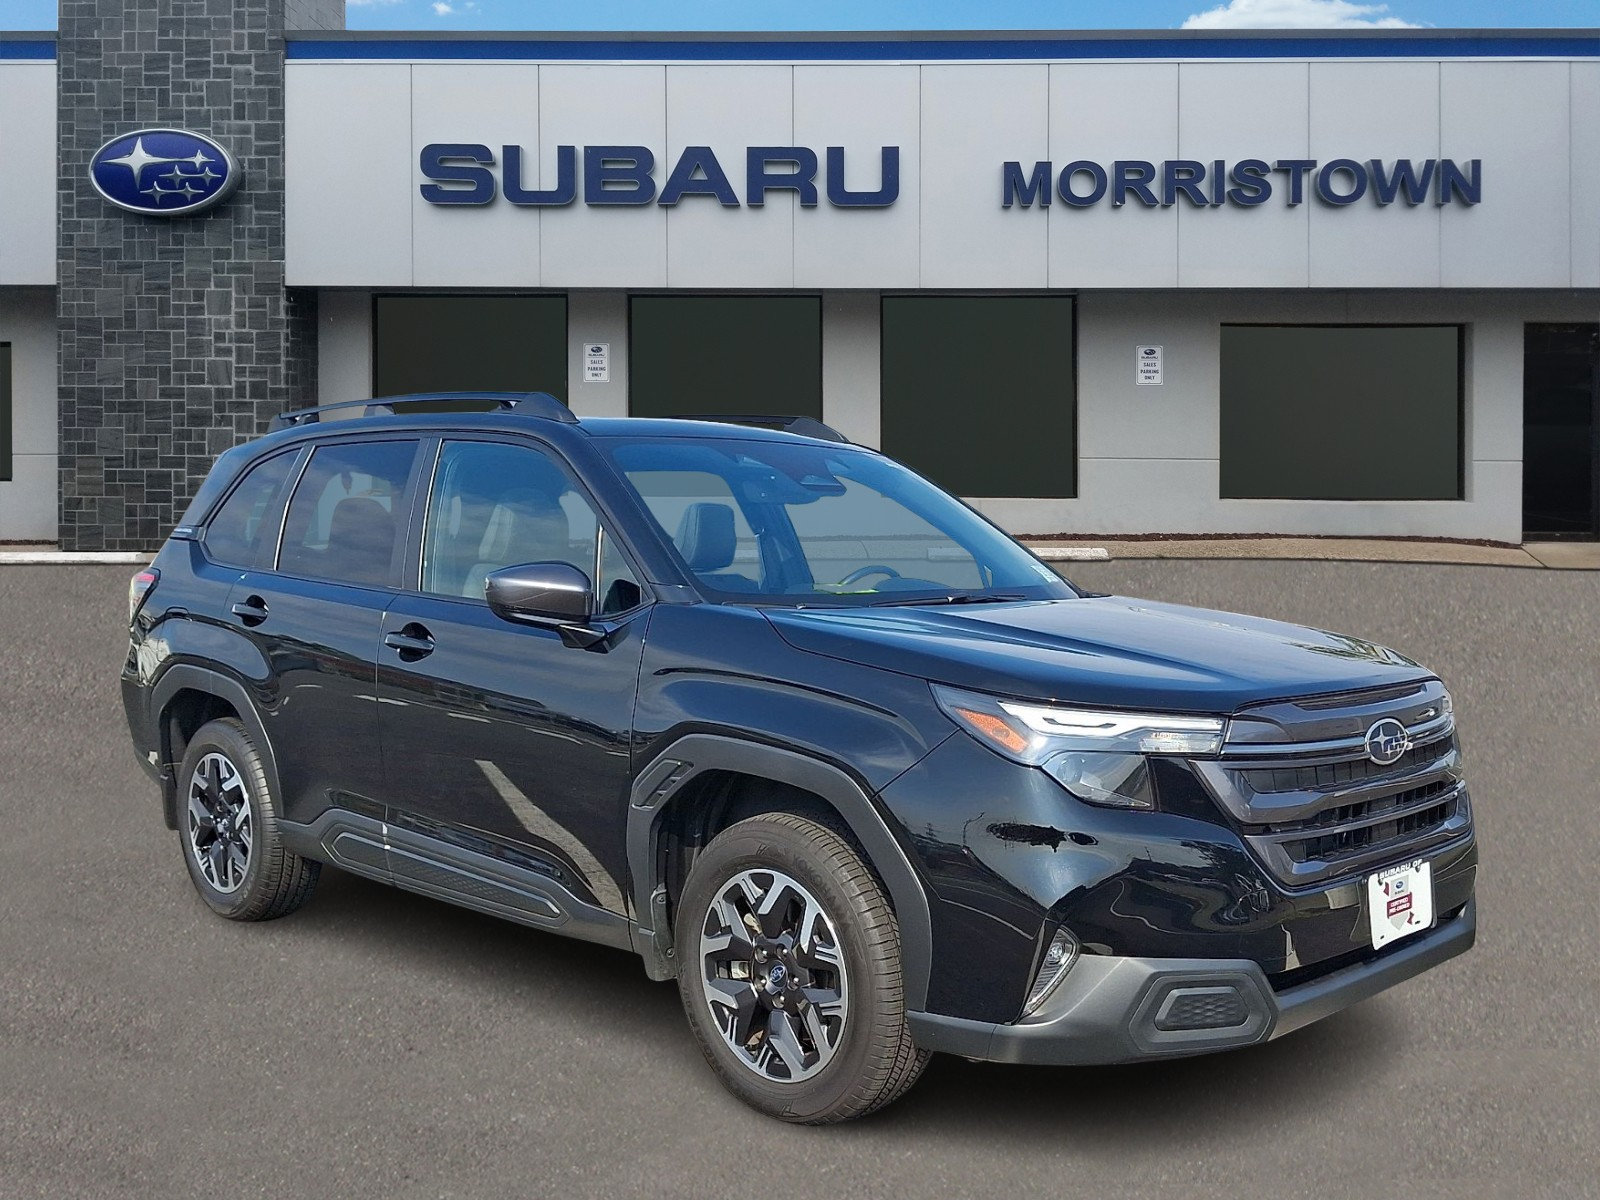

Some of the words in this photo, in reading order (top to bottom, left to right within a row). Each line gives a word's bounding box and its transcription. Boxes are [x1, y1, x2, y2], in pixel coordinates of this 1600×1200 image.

[420, 144, 899, 208] SUBARU
[1001, 158, 1481, 209] MORRISTOWN
[1379, 863, 1411, 879] SUBARU
[1412, 858, 1422, 868] OF
